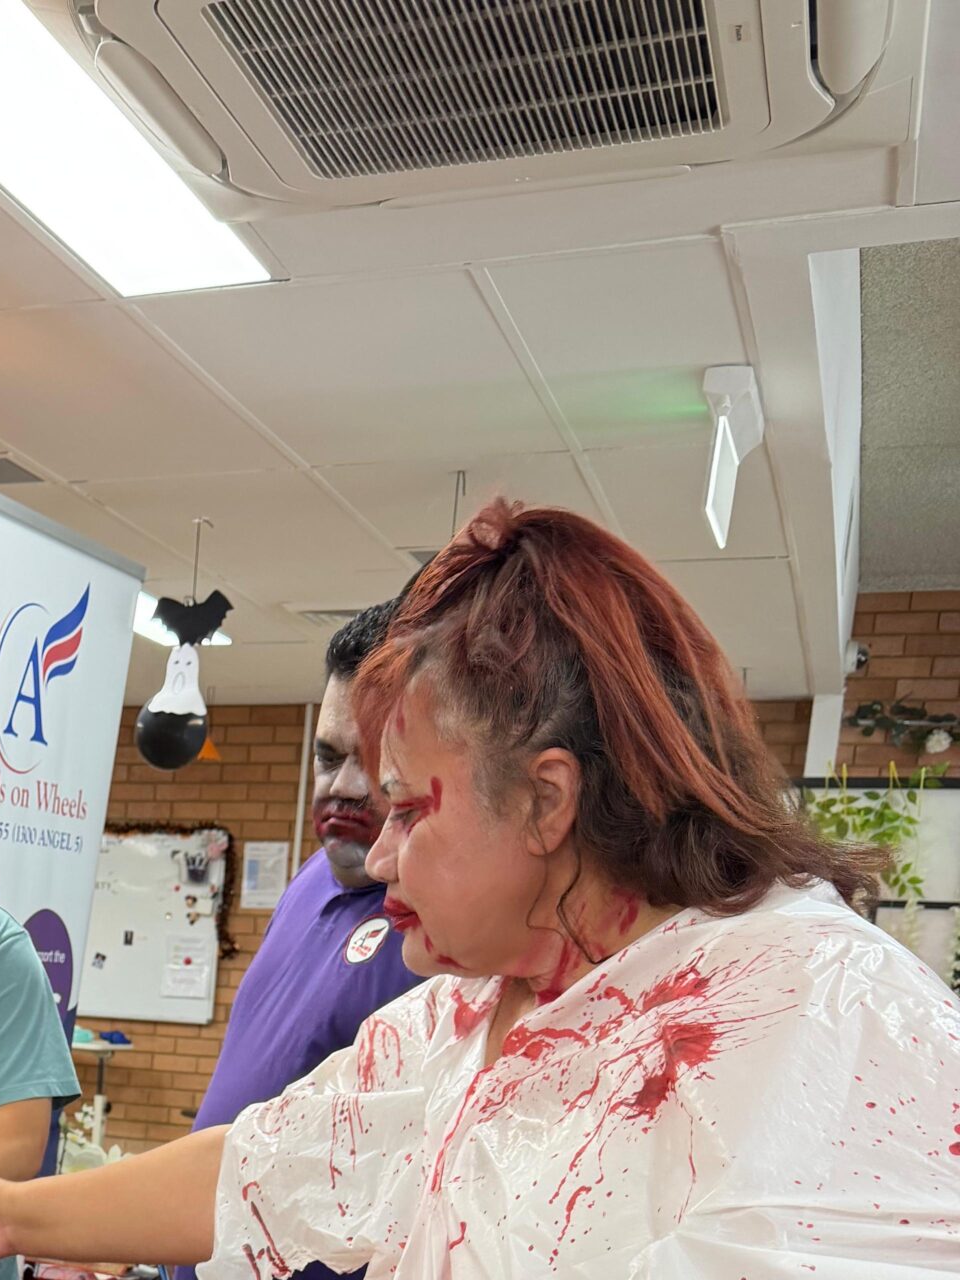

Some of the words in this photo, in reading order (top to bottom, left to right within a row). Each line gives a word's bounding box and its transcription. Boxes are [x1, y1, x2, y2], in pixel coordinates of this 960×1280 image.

[10, 785, 30, 809] on
[36, 779, 88, 821] Wheels
[11, 822, 38, 845] (1300
[36, 827, 72, 852] ANGEL
[74, 833, 84, 854] 5)
[53, 950, 66, 964] the
